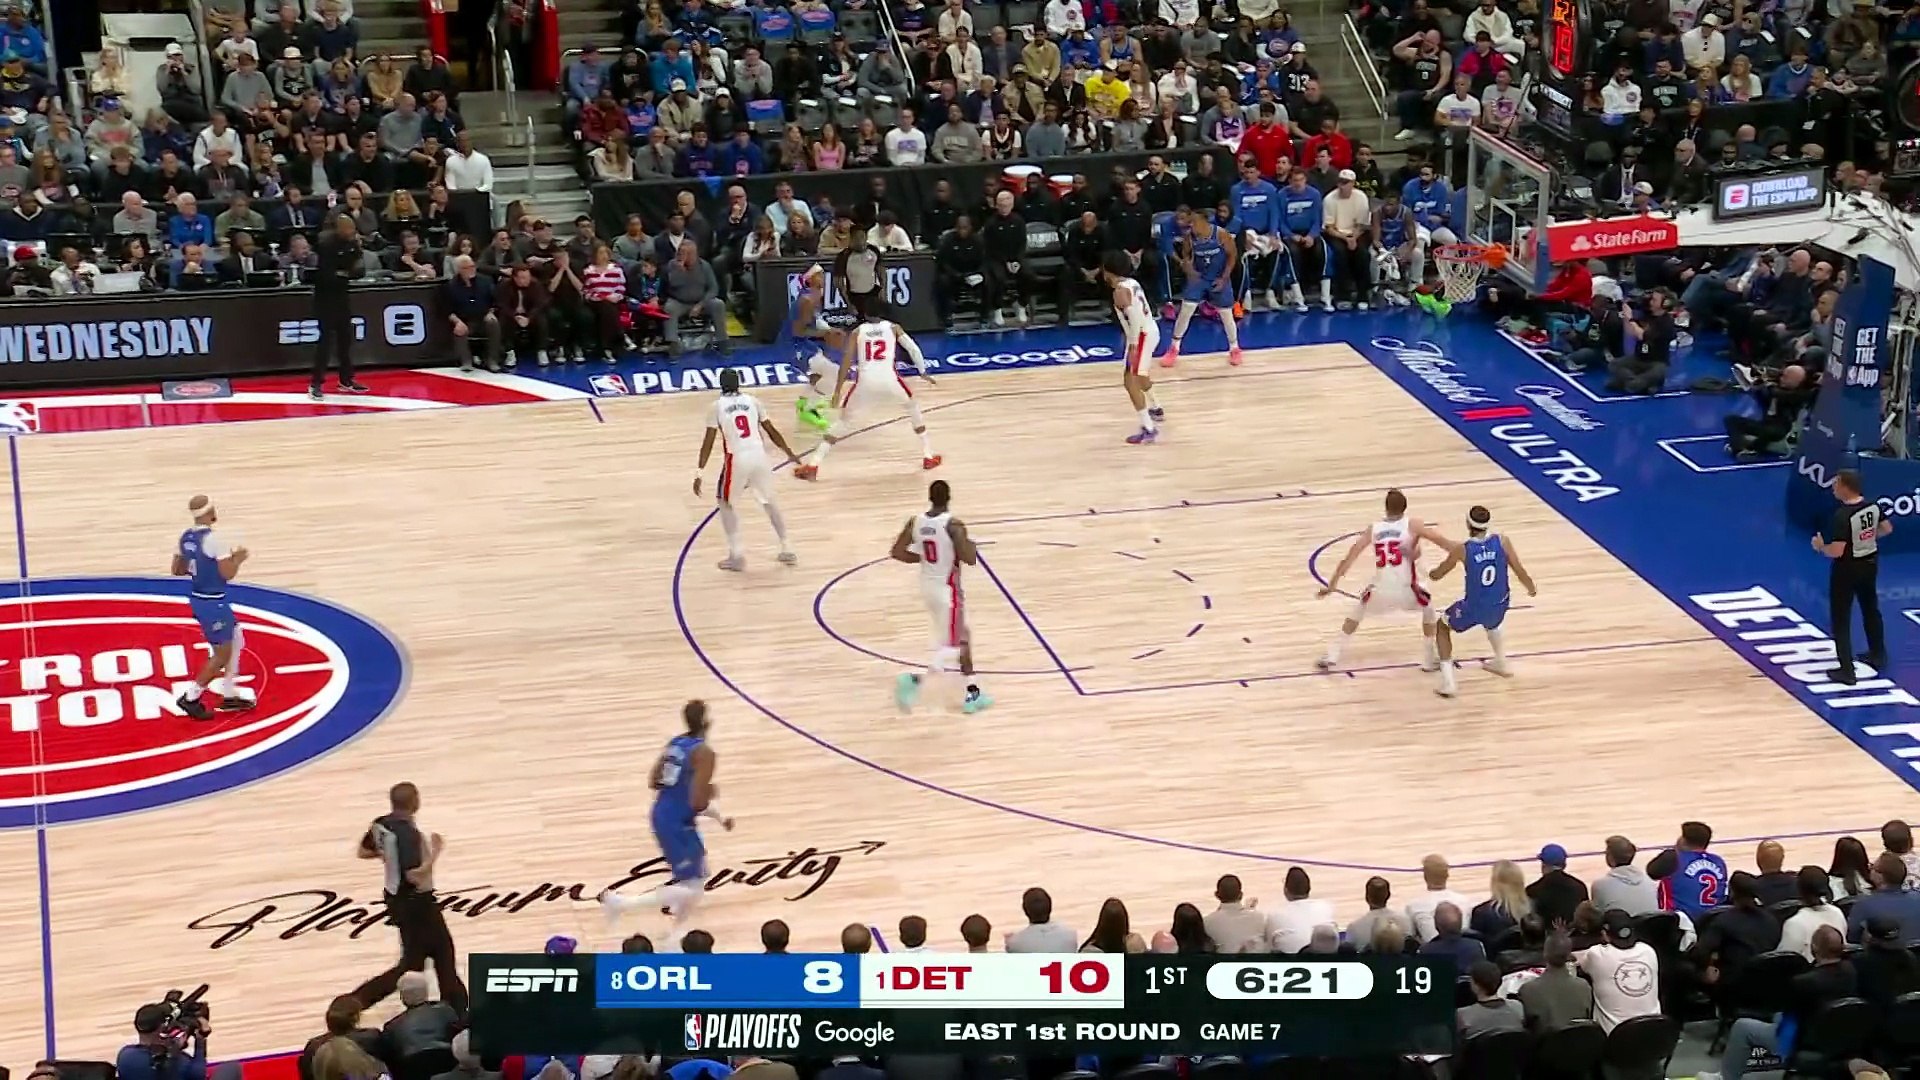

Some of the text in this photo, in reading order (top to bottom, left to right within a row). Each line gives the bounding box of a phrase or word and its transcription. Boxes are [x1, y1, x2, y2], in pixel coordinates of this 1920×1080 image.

[865, 340, 887, 360] 12
[946, 344, 1114, 369] Google
[1855, 347, 1875, 364] THE
[633, 363, 810, 394] PLAYOFF
[734, 415, 750, 438] 9
[1490, 422, 1621, 502] ULTRA
[923, 540, 938, 564] 0
[1374, 541, 1403, 568] 55
[1481, 565, 1496, 586] 0
[1688, 585, 1920, 708] DETROIT
[1699, 873, 1718, 906] 2
